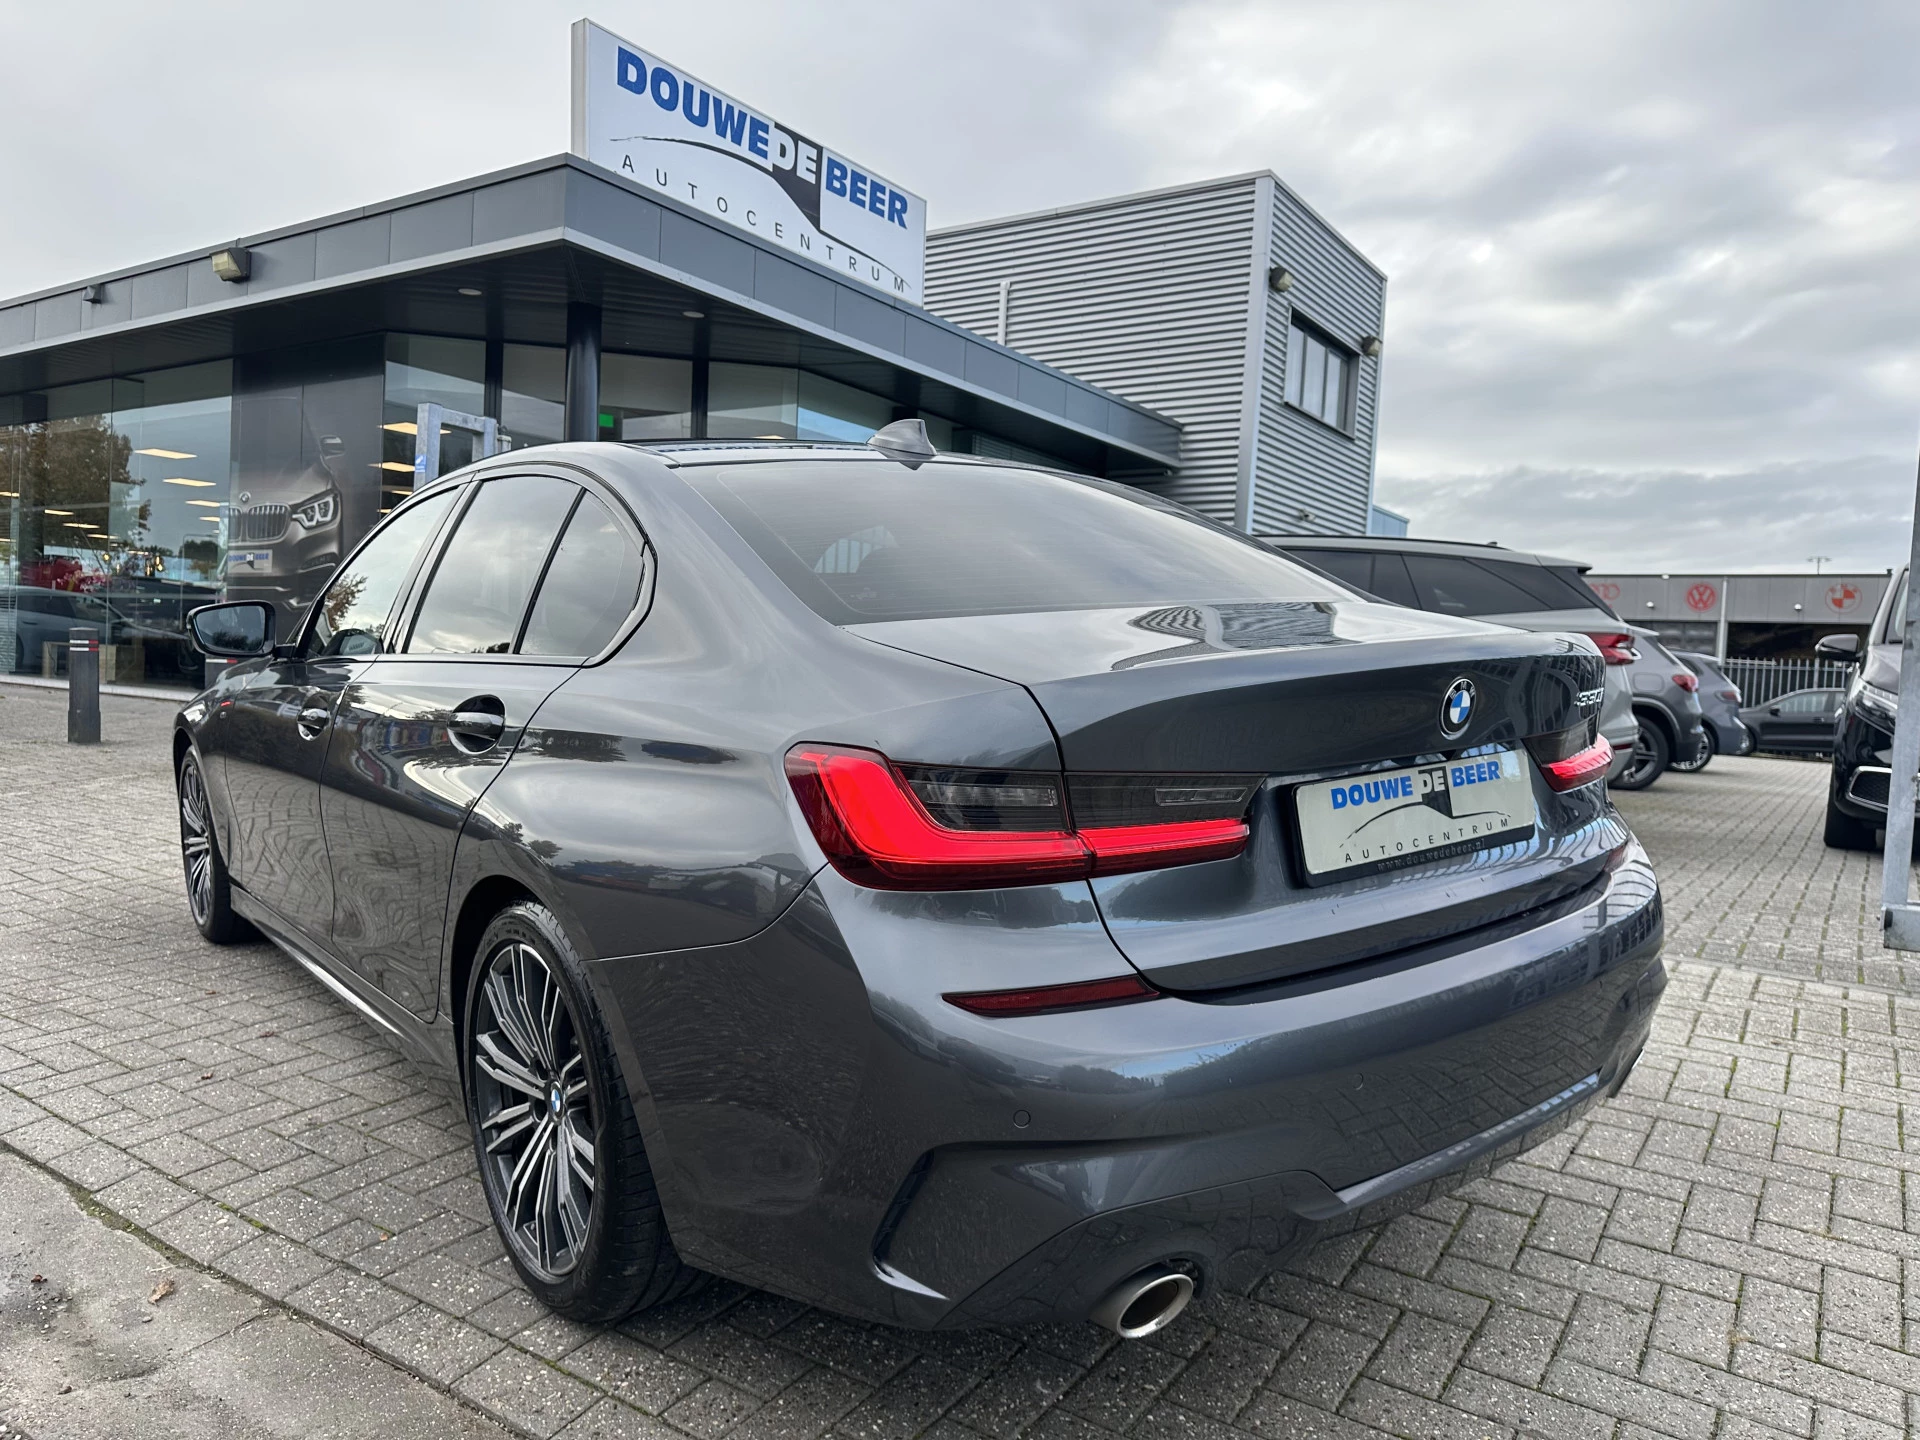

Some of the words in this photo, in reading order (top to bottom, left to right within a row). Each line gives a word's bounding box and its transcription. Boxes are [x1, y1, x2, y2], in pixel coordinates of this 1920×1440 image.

[616, 45, 770, 160] DOUWE
[772, 127, 819, 184] DE
[825, 155, 909, 230] BEER
[621, 154, 905, 293] AUTOCENTRUM
[1331, 775, 1414, 810] DOUWE
[1420, 769, 1446, 795] DE
[1450, 760, 1501, 788] BEER
[1344, 818, 1509, 863] AUTOCENTRUM
[1377, 838, 1486, 872] www.douwedebeer.nl
